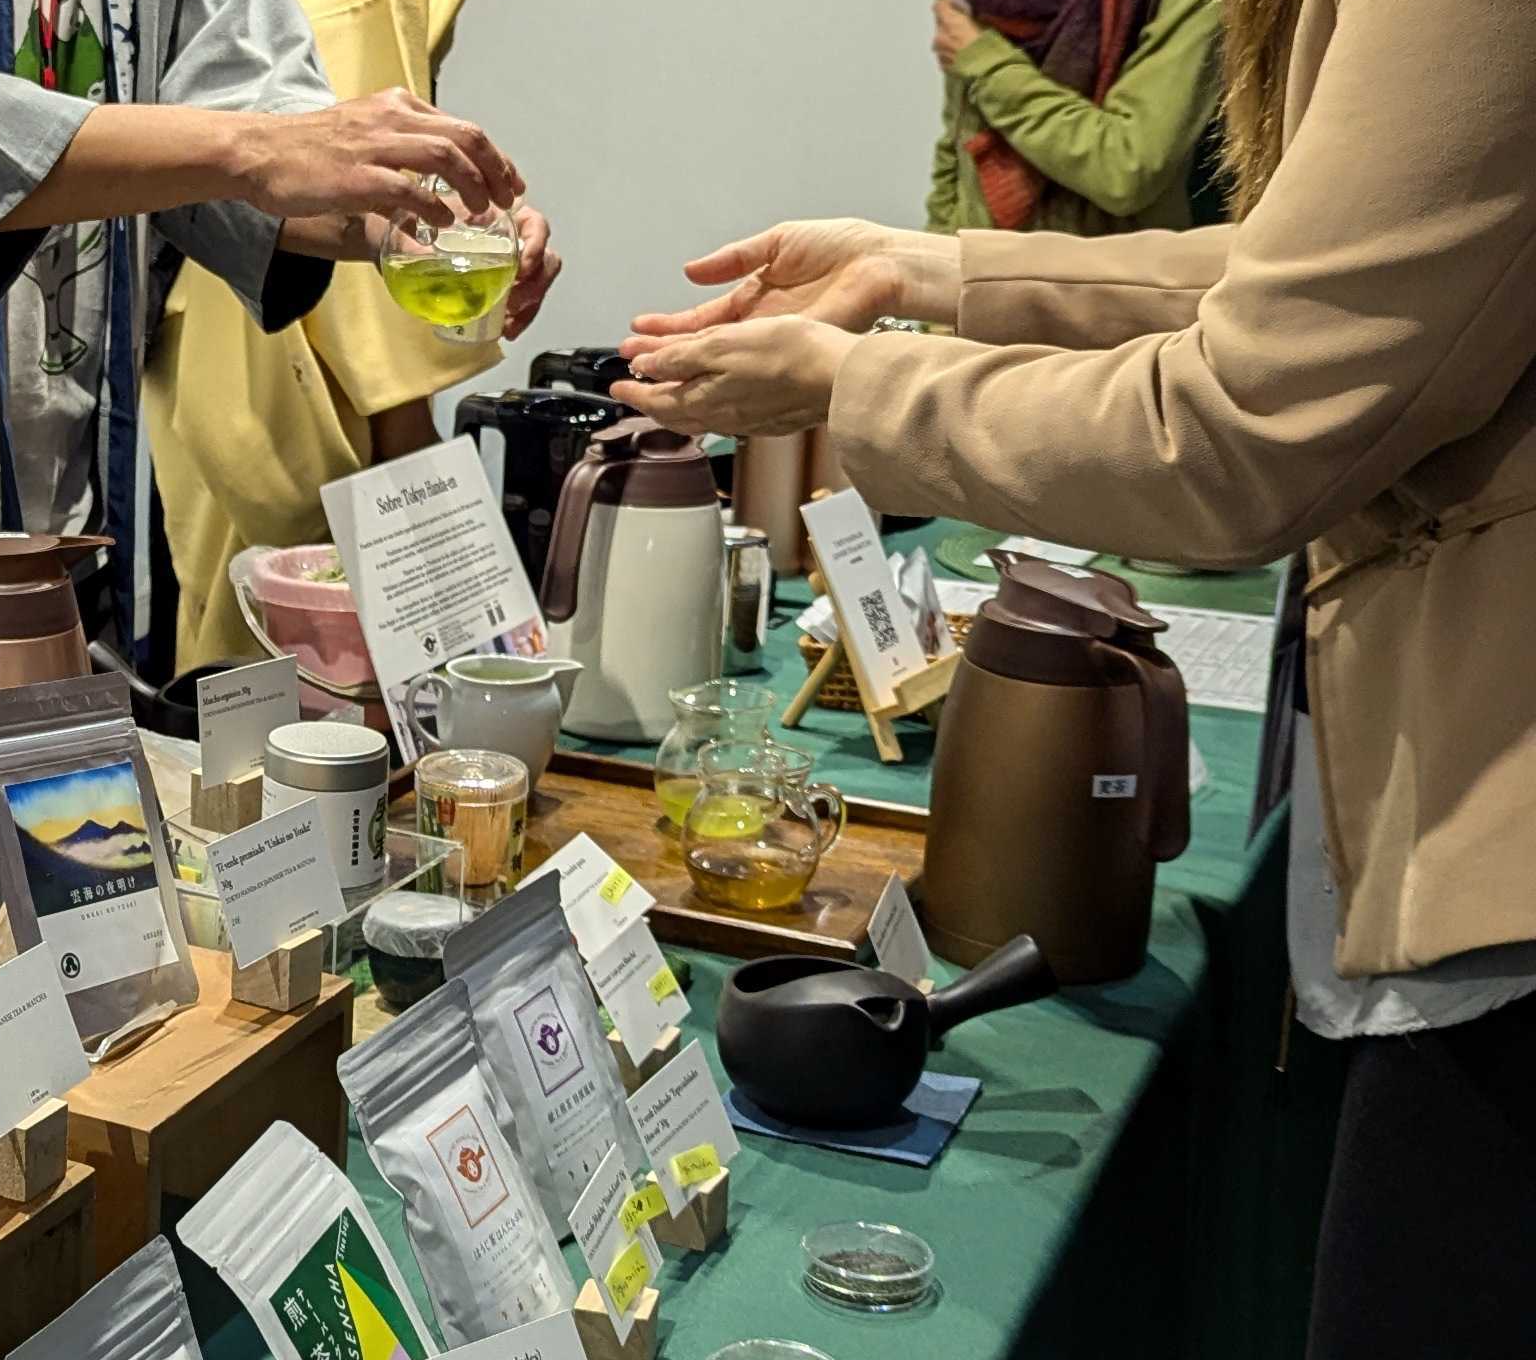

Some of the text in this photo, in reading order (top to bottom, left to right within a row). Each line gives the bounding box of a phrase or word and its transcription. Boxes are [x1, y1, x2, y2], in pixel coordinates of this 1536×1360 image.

[376, 495, 403, 514] Sobre
[70, 876, 134, 903] 雲海の夜明け
[324, 1263, 360, 1360] SENCHA
